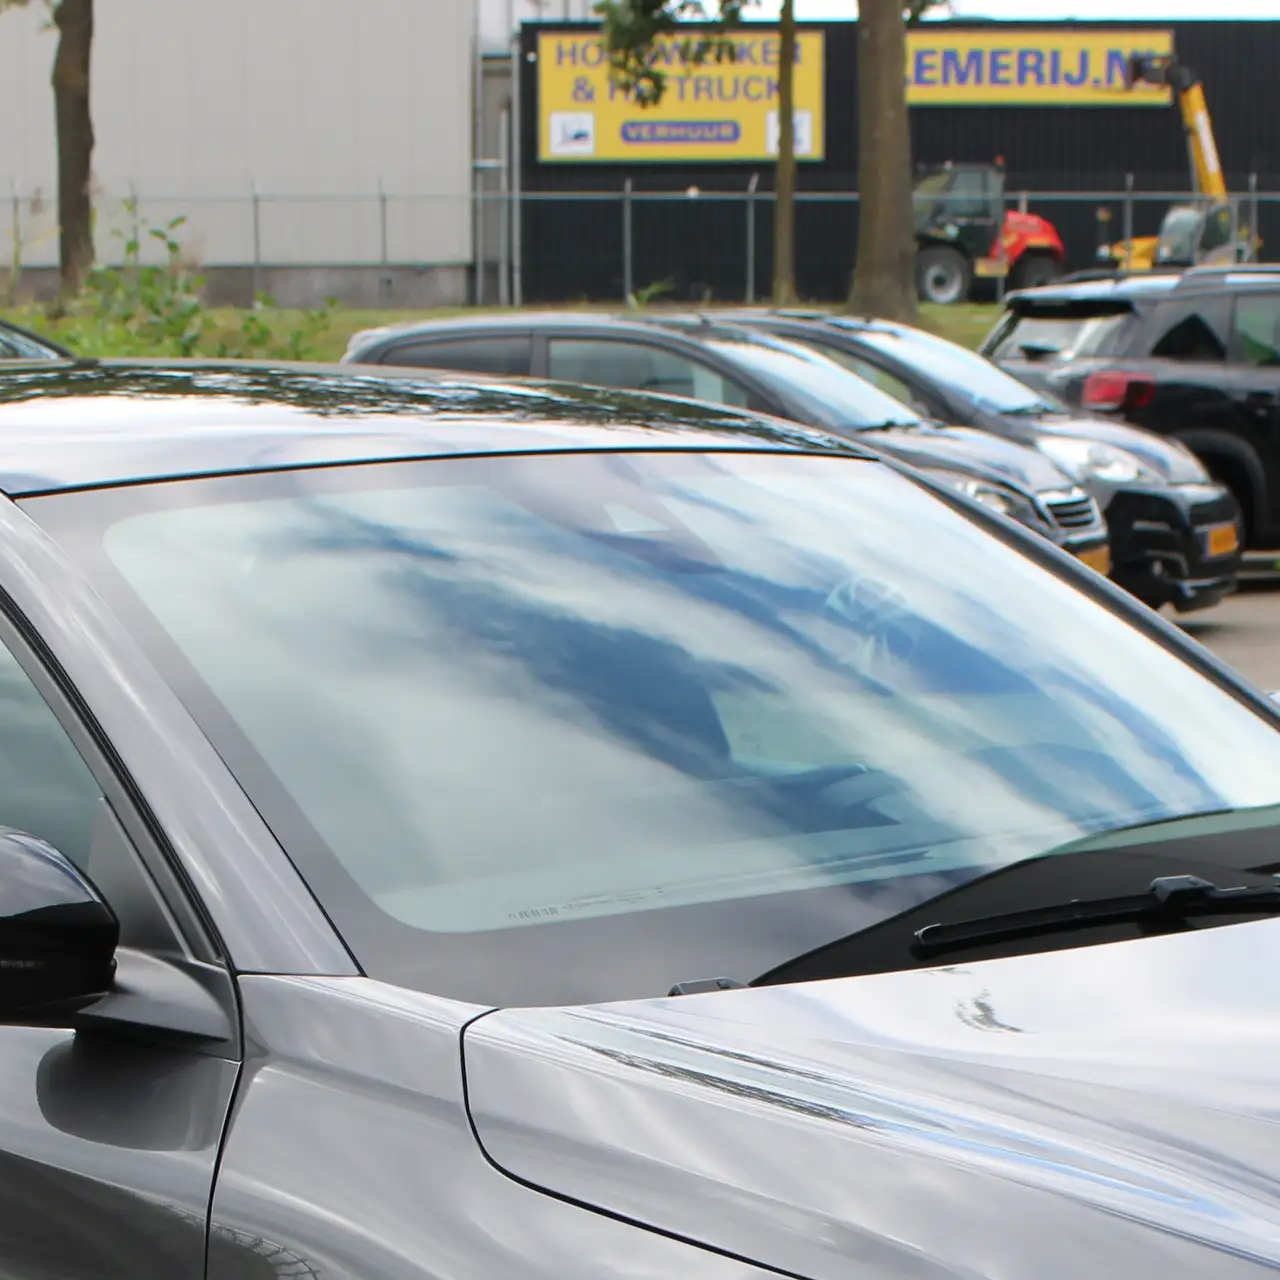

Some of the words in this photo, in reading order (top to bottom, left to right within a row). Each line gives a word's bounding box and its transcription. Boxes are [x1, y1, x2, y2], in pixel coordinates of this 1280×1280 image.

[905, 48, 1161, 87] EMERIJ.N
[572, 75, 595, 102] &
[609, 75, 781, 102] HTRUCK
[625, 124, 735, 139] VERHUUR
